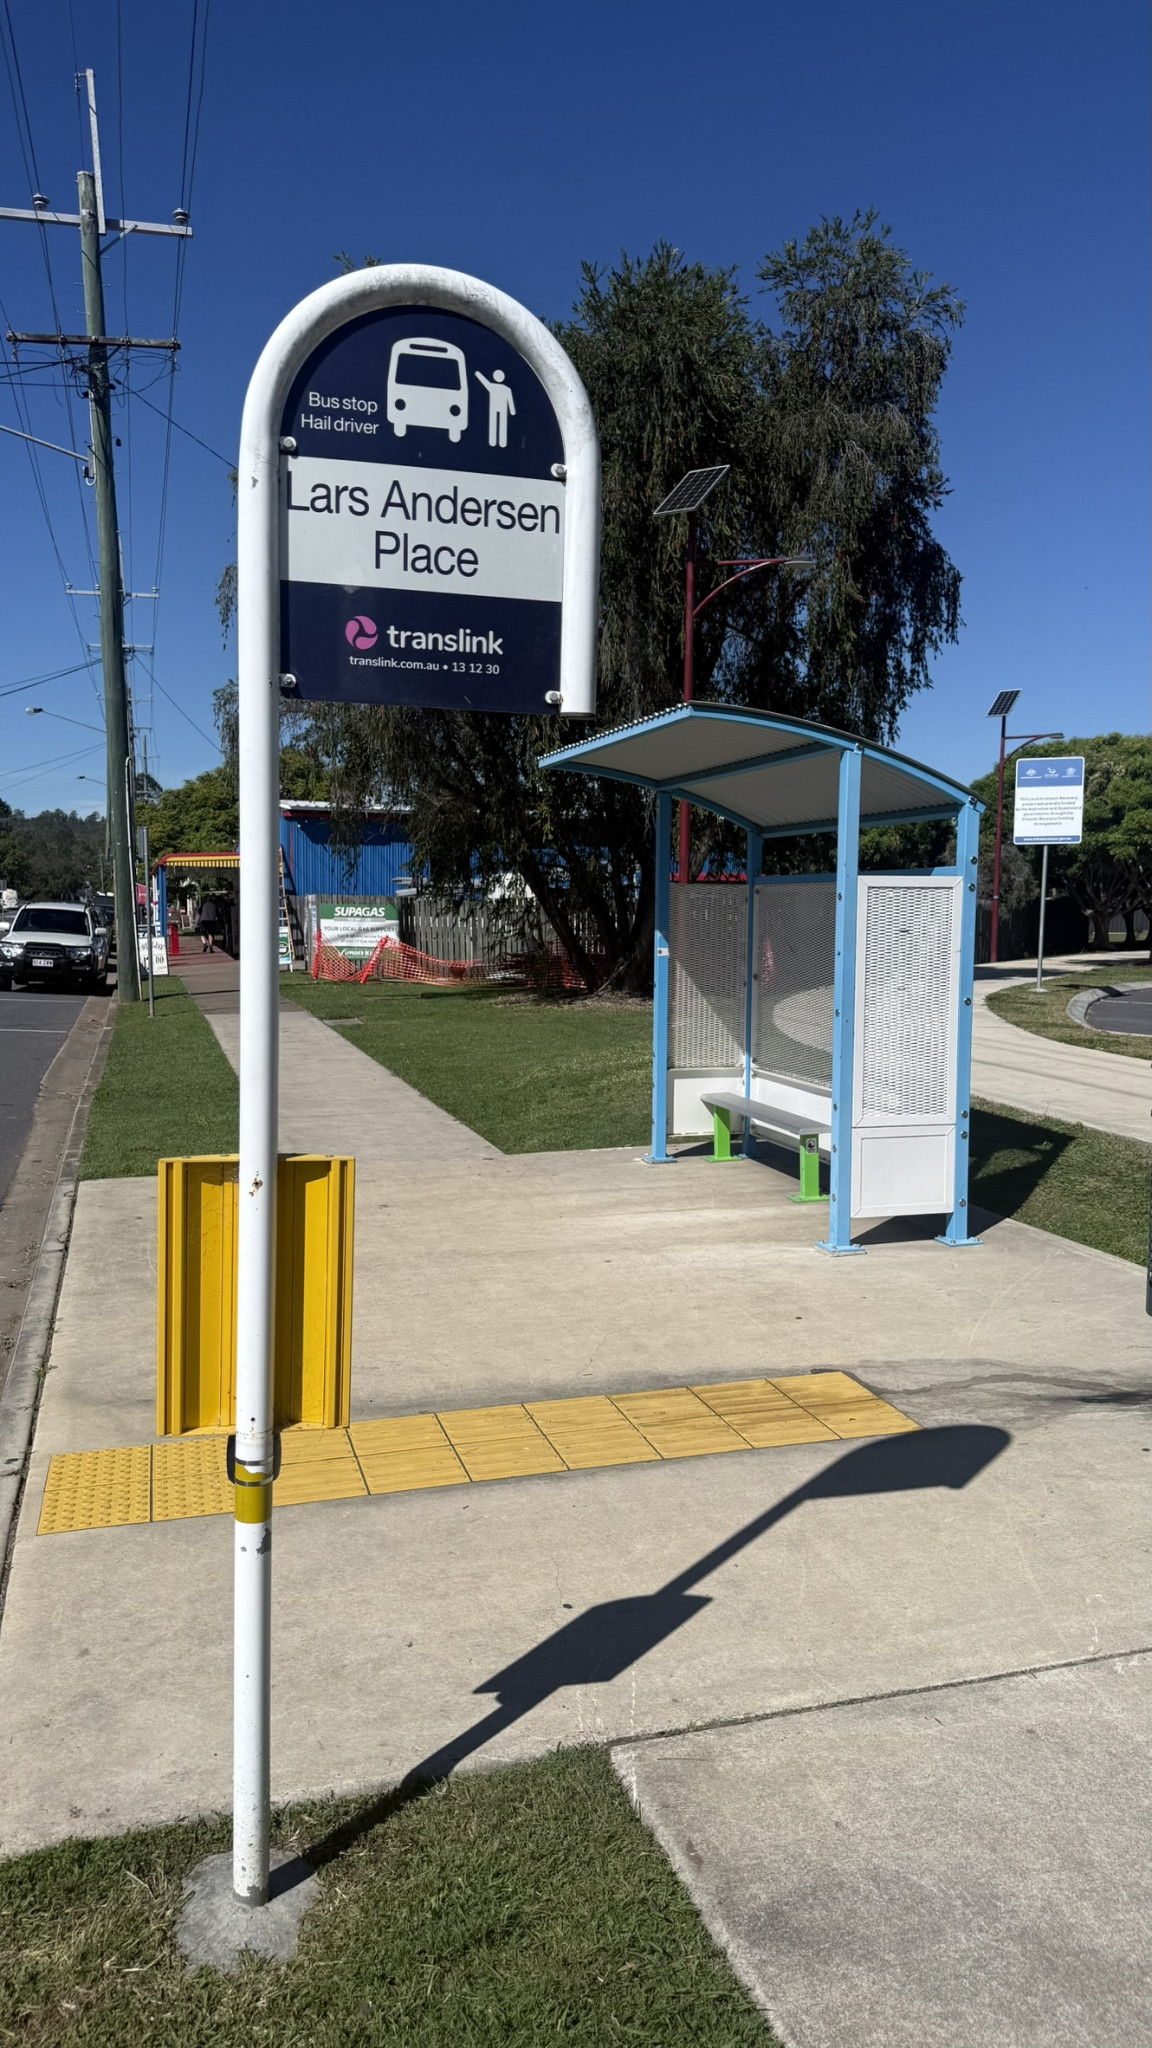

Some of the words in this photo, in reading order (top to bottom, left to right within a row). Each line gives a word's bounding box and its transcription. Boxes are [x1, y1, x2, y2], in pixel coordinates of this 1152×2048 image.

[308, 391, 340, 409] Bus
[342, 396, 378, 416] stop
[301, 413, 331, 430] Hail
[333, 416, 380, 435] driver
[286, 470, 370, 517] Lars
[380, 479, 560, 534] Andersen
[374, 530, 479, 577] Place
[386, 625, 504, 655] translink
[348, 655, 440, 671] translink.com.au
[451, 662, 466, 673] 13
[469, 662, 483, 674] 12
[485, 664, 500, 675] 30
[334, 906, 386, 916] SUPAGAS
